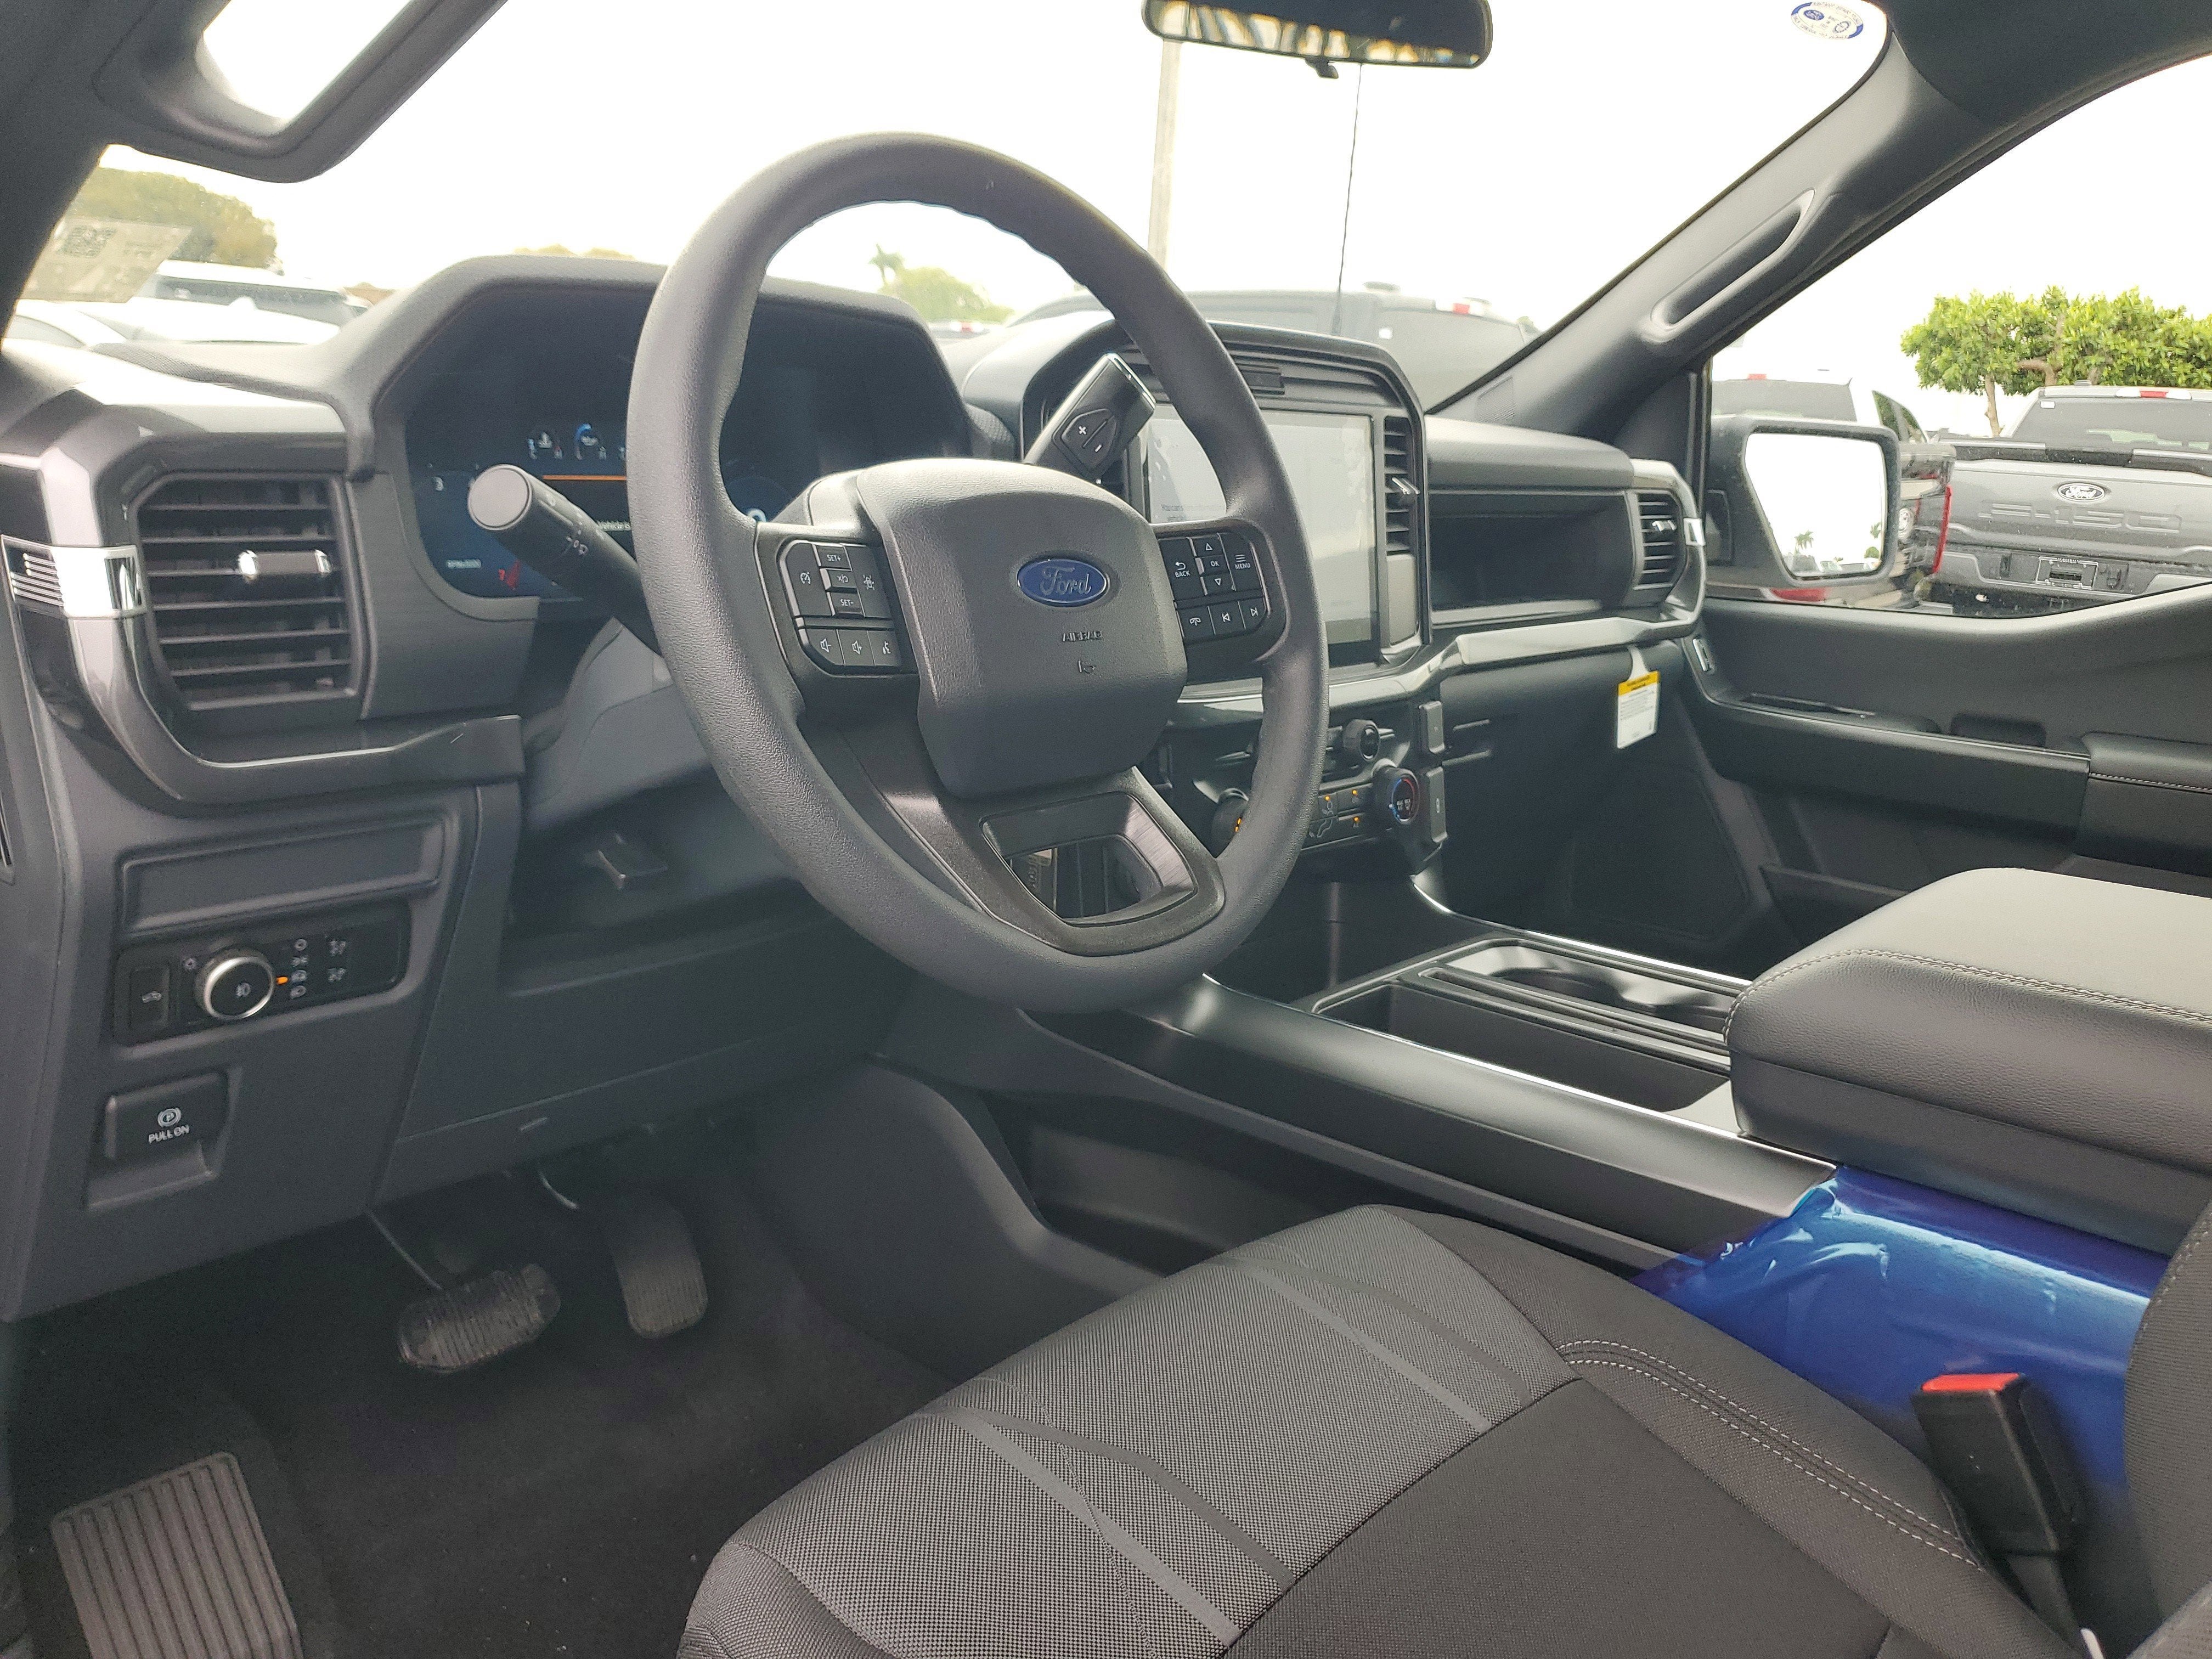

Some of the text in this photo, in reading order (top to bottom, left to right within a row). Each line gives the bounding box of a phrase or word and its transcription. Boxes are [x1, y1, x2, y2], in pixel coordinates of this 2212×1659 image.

[1040, 566, 1092, 596] Ford
[1175, 569, 1190, 578] BACK
[148, 1124, 190, 1144] PULL ON
